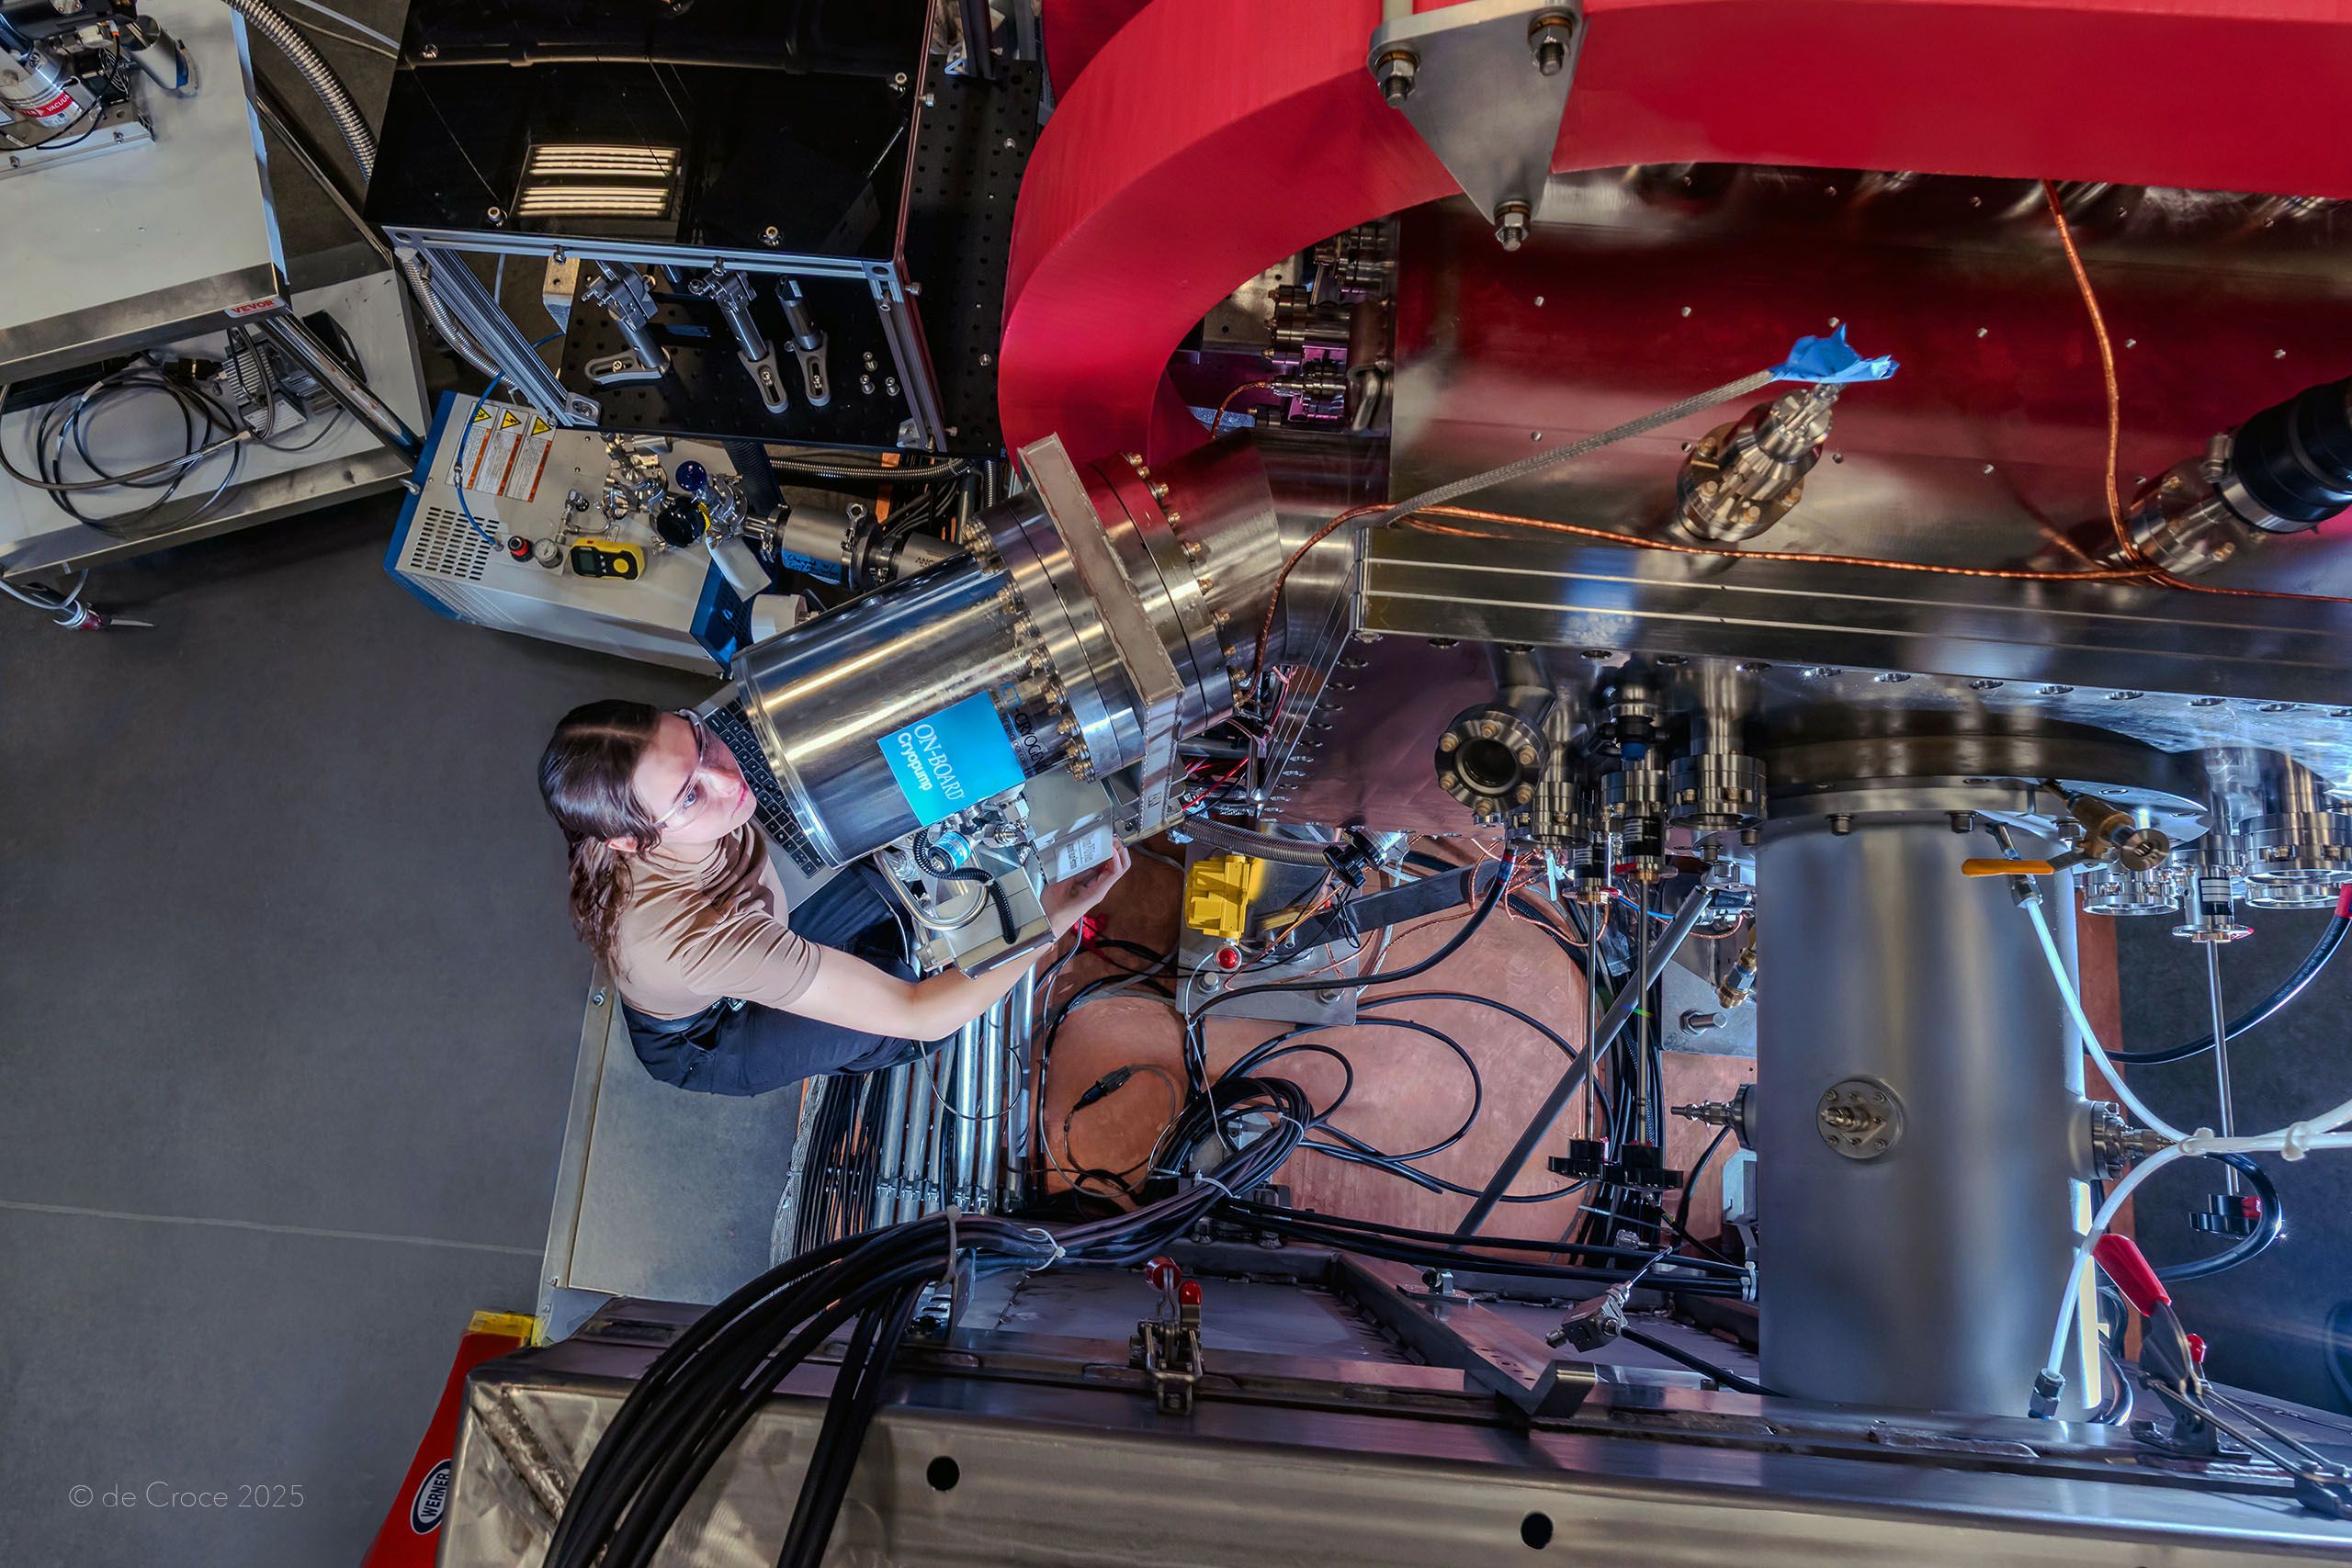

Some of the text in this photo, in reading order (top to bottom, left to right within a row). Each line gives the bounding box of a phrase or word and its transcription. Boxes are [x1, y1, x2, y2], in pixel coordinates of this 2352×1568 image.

[231, 299, 274, 313] VEVOR
[898, 732, 933, 791] Cryopump
[914, 724, 965, 800] ON-BOARD
[421, 1472, 449, 1517] WERNER
